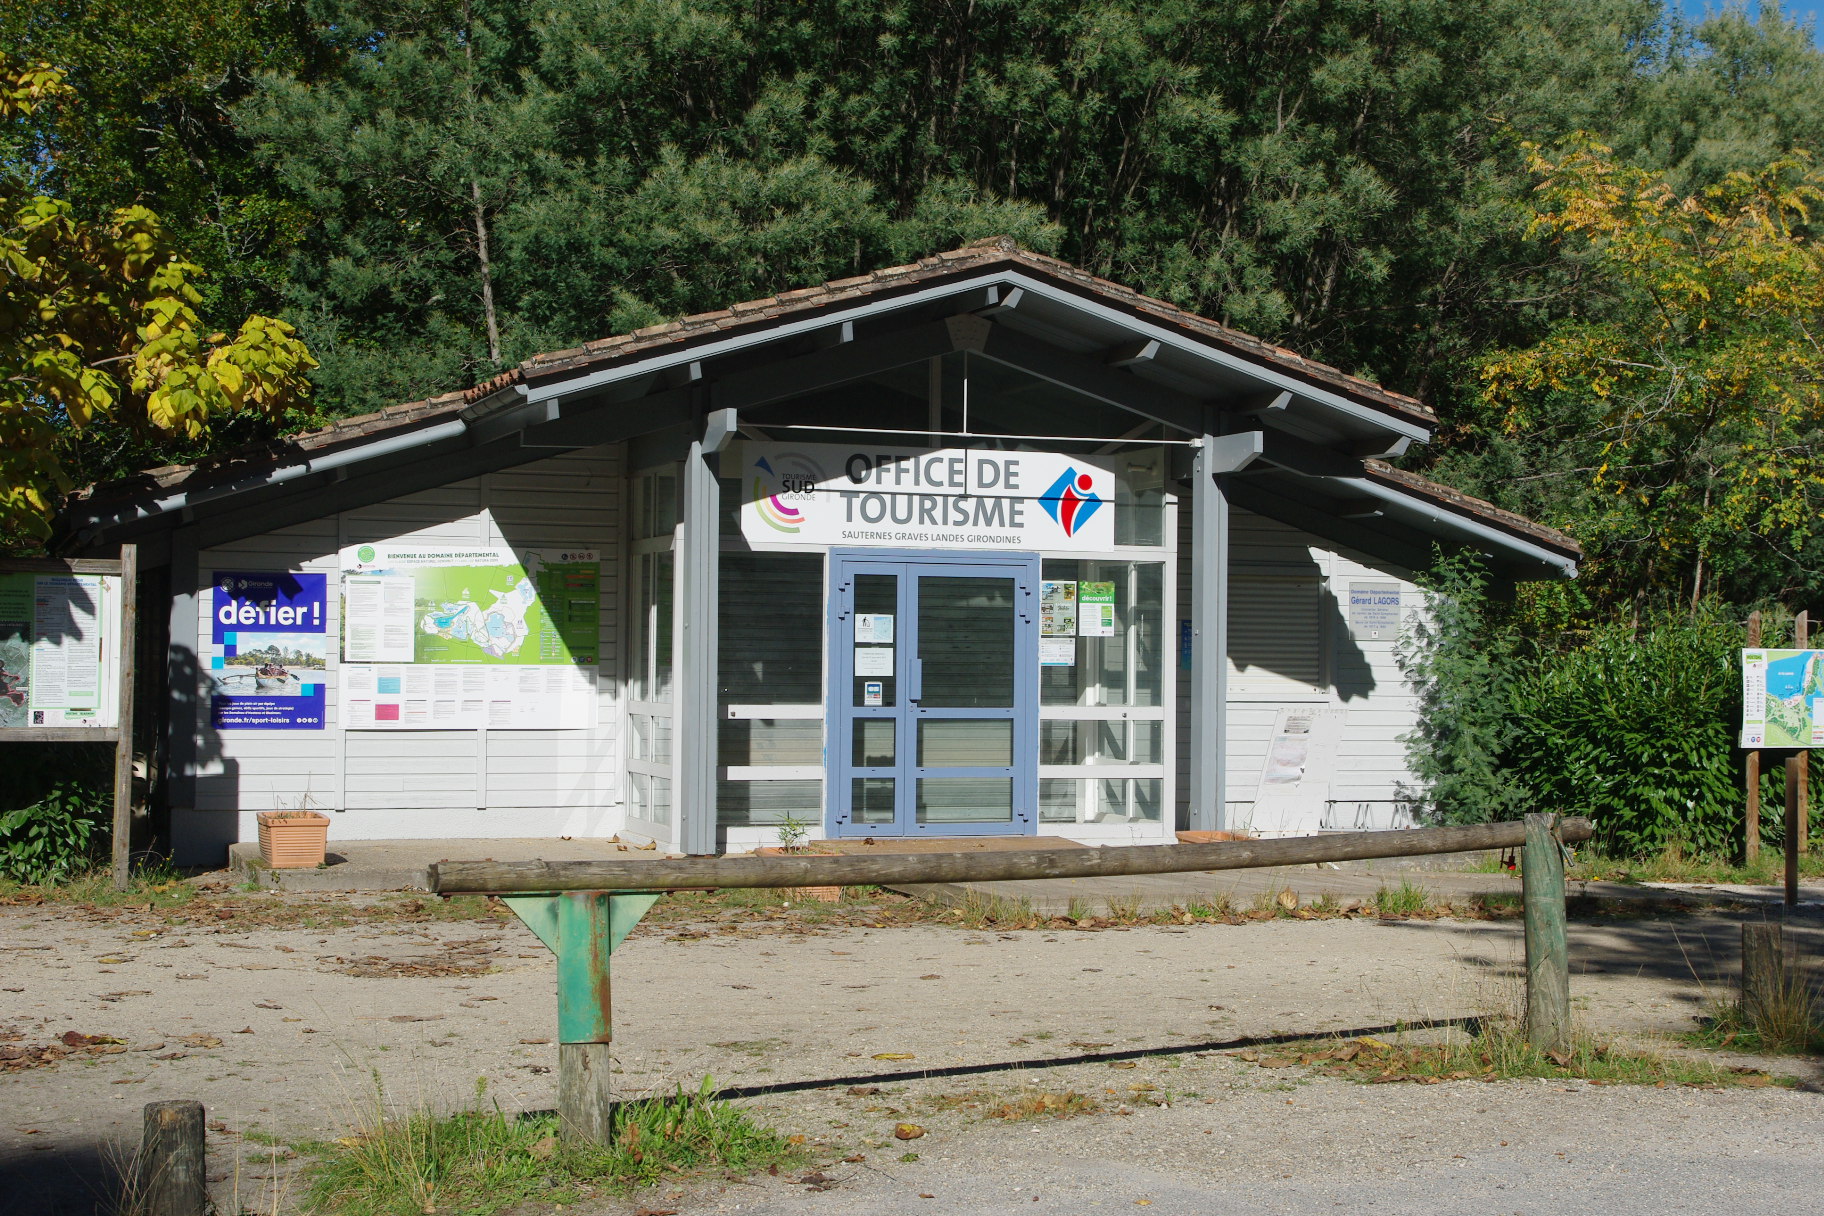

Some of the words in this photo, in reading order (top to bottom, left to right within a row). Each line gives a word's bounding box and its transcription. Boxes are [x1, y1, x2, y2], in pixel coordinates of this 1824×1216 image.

[783, 473, 817, 481] TOURISME
[845, 453, 964, 487] OFFICE
[977, 458, 1020, 490] DE
[782, 480, 814, 494] SUD
[782, 493, 816, 501] GIRONDE
[839, 491, 1025, 528] TOURISME
[842, 530, 892, 540] SAUTERNES
[895, 532, 929, 541] GRAVES
[931, 533, 965, 542] LANDES
[967, 534, 1022, 544] GIRONDINES
[1351, 596, 1372, 605] Gérard
[1373, 596, 1400, 605] LAGORS
[218, 598, 308, 625] défier
[312, 601, 320, 626] !
